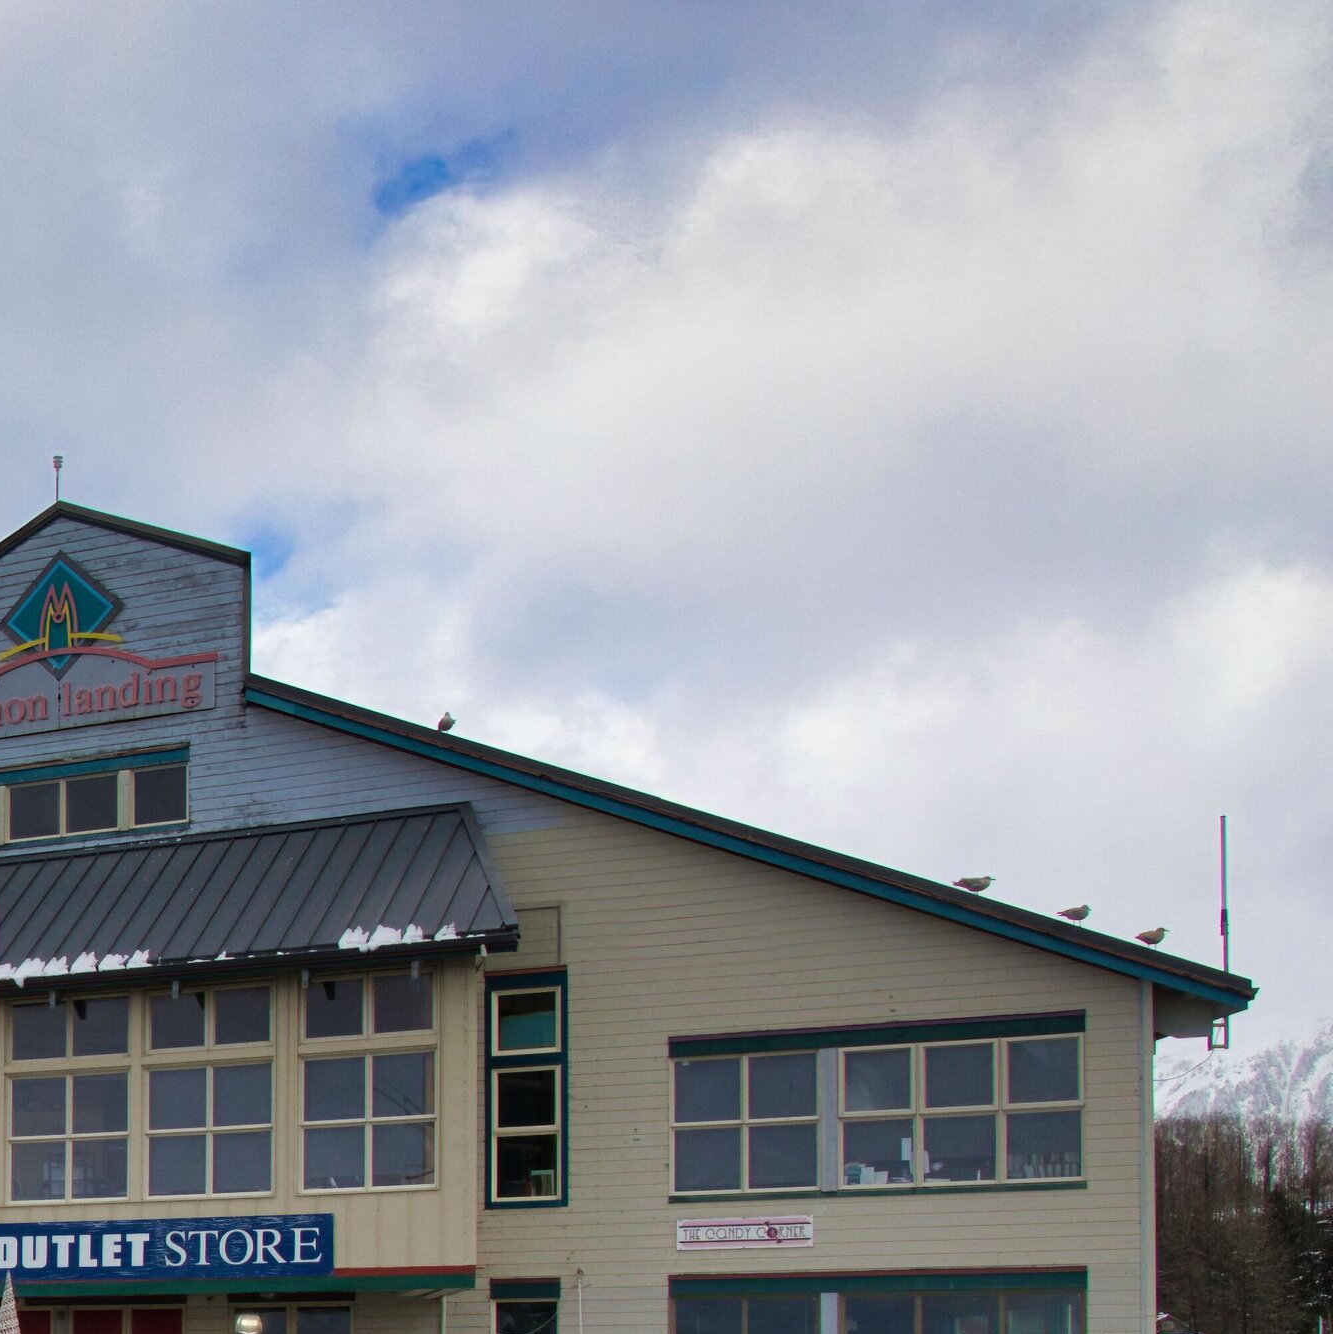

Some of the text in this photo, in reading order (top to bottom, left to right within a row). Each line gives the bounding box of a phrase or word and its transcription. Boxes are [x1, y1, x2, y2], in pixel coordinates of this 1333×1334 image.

[61, 671, 203, 709] landing
[164, 1226, 323, 1268] STORE
[683, 1228, 701, 1241] THE
[705, 1227, 751, 1240] CANDY
